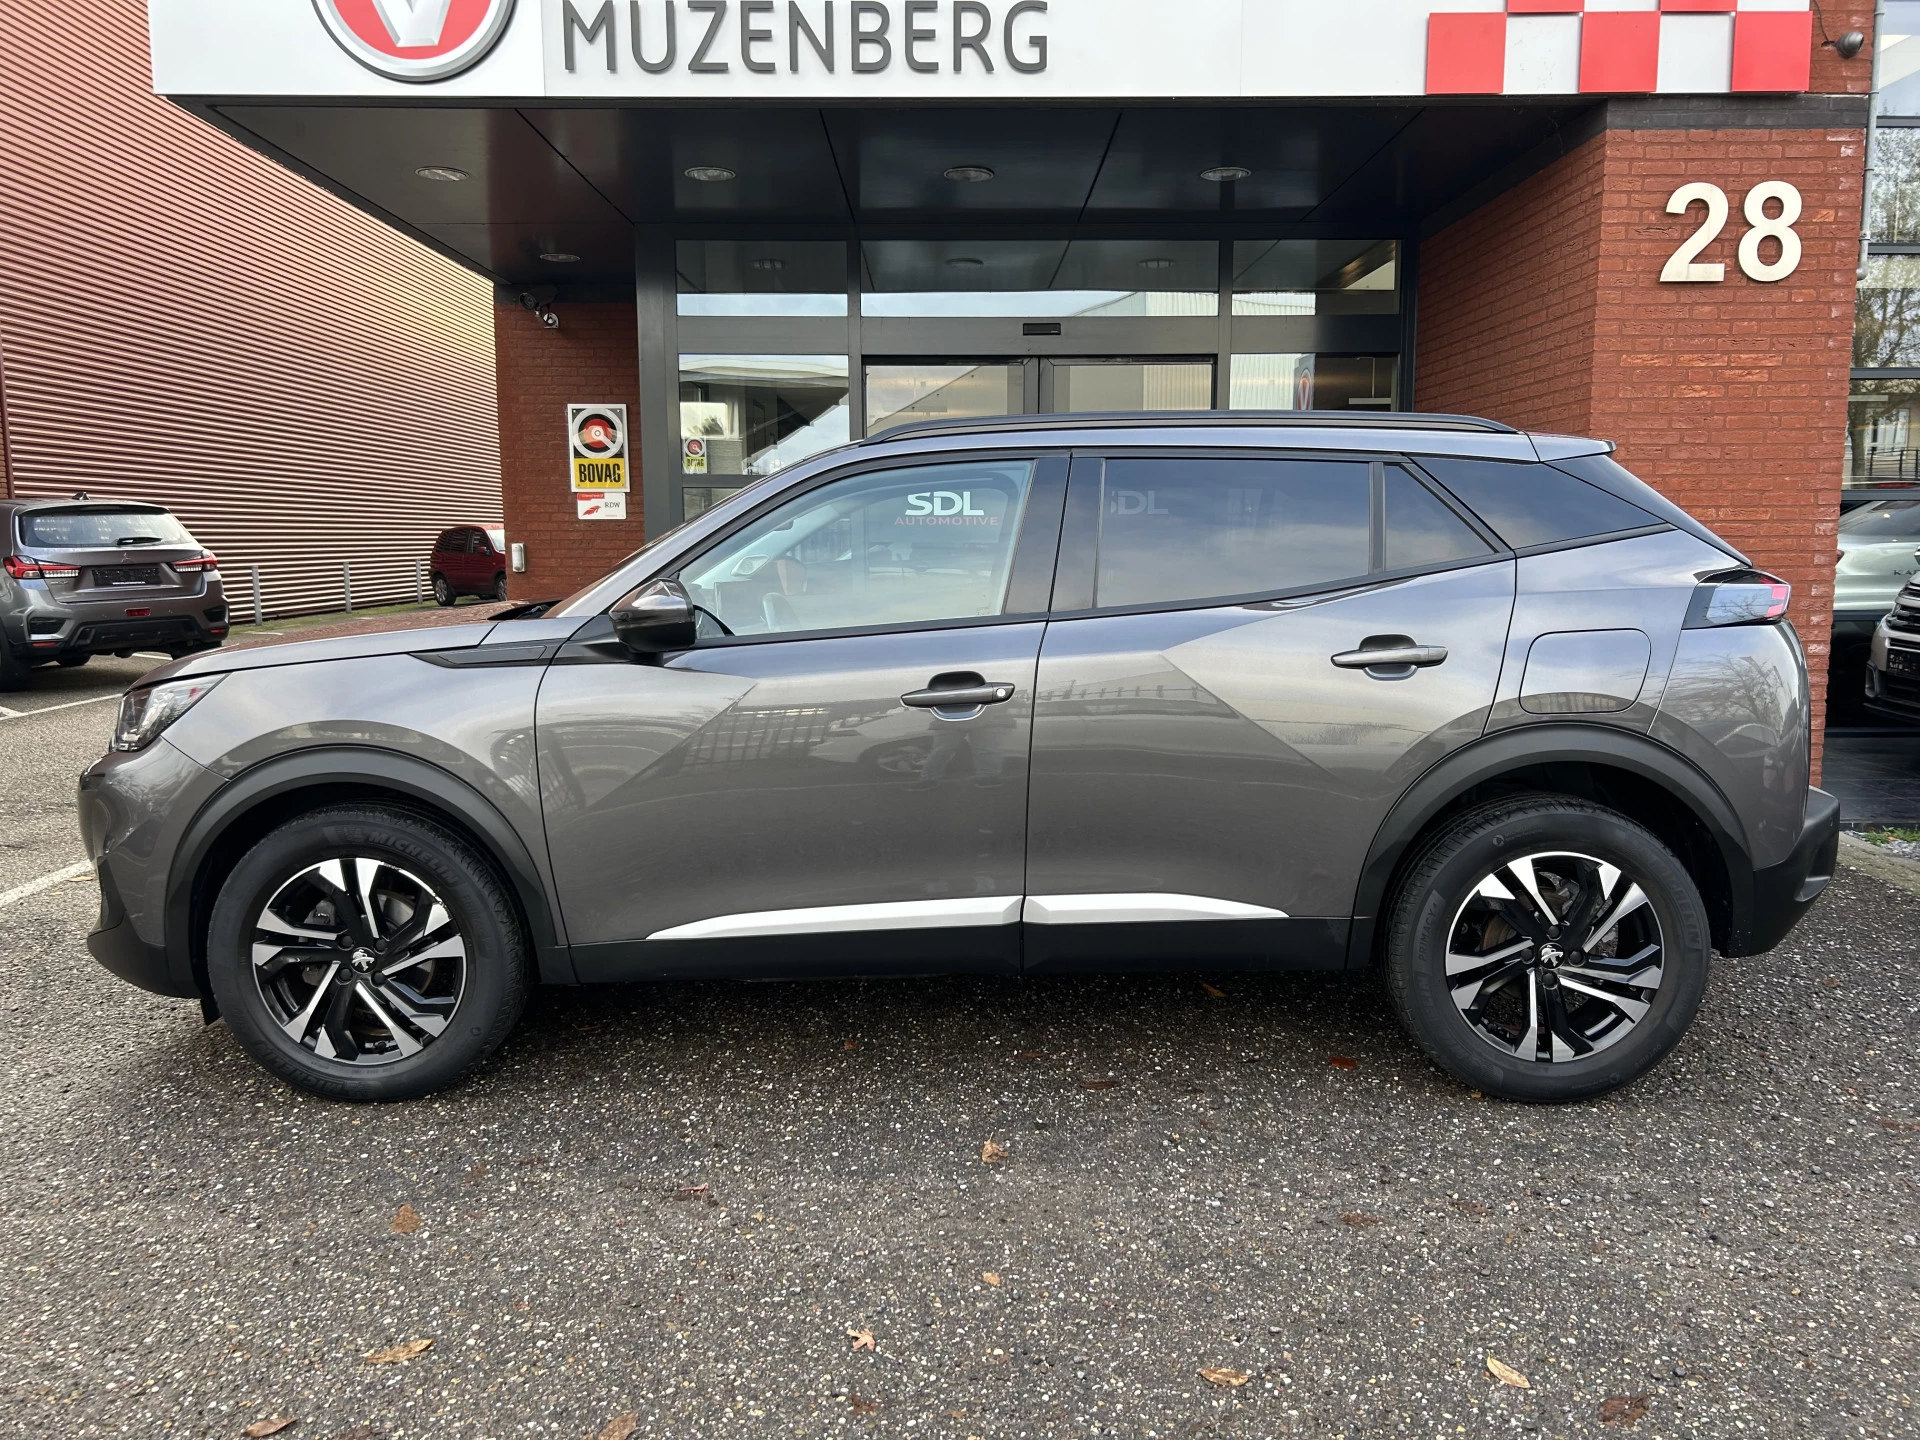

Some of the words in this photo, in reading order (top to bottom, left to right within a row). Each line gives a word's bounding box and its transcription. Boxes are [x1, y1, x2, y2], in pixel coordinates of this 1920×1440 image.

[563, 0, 1049, 72] MUZENBERG
[1660, 180, 1802, 282] 28
[578, 463, 621, 483] BOVAG
[894, 516, 998, 526] AUTOMOTIVE
[905, 491, 984, 516] SDL
[1110, 490, 1169, 515] DL
[368, 830, 460, 888] MICHELIN
[1418, 908, 1435, 962] PRIMACY
